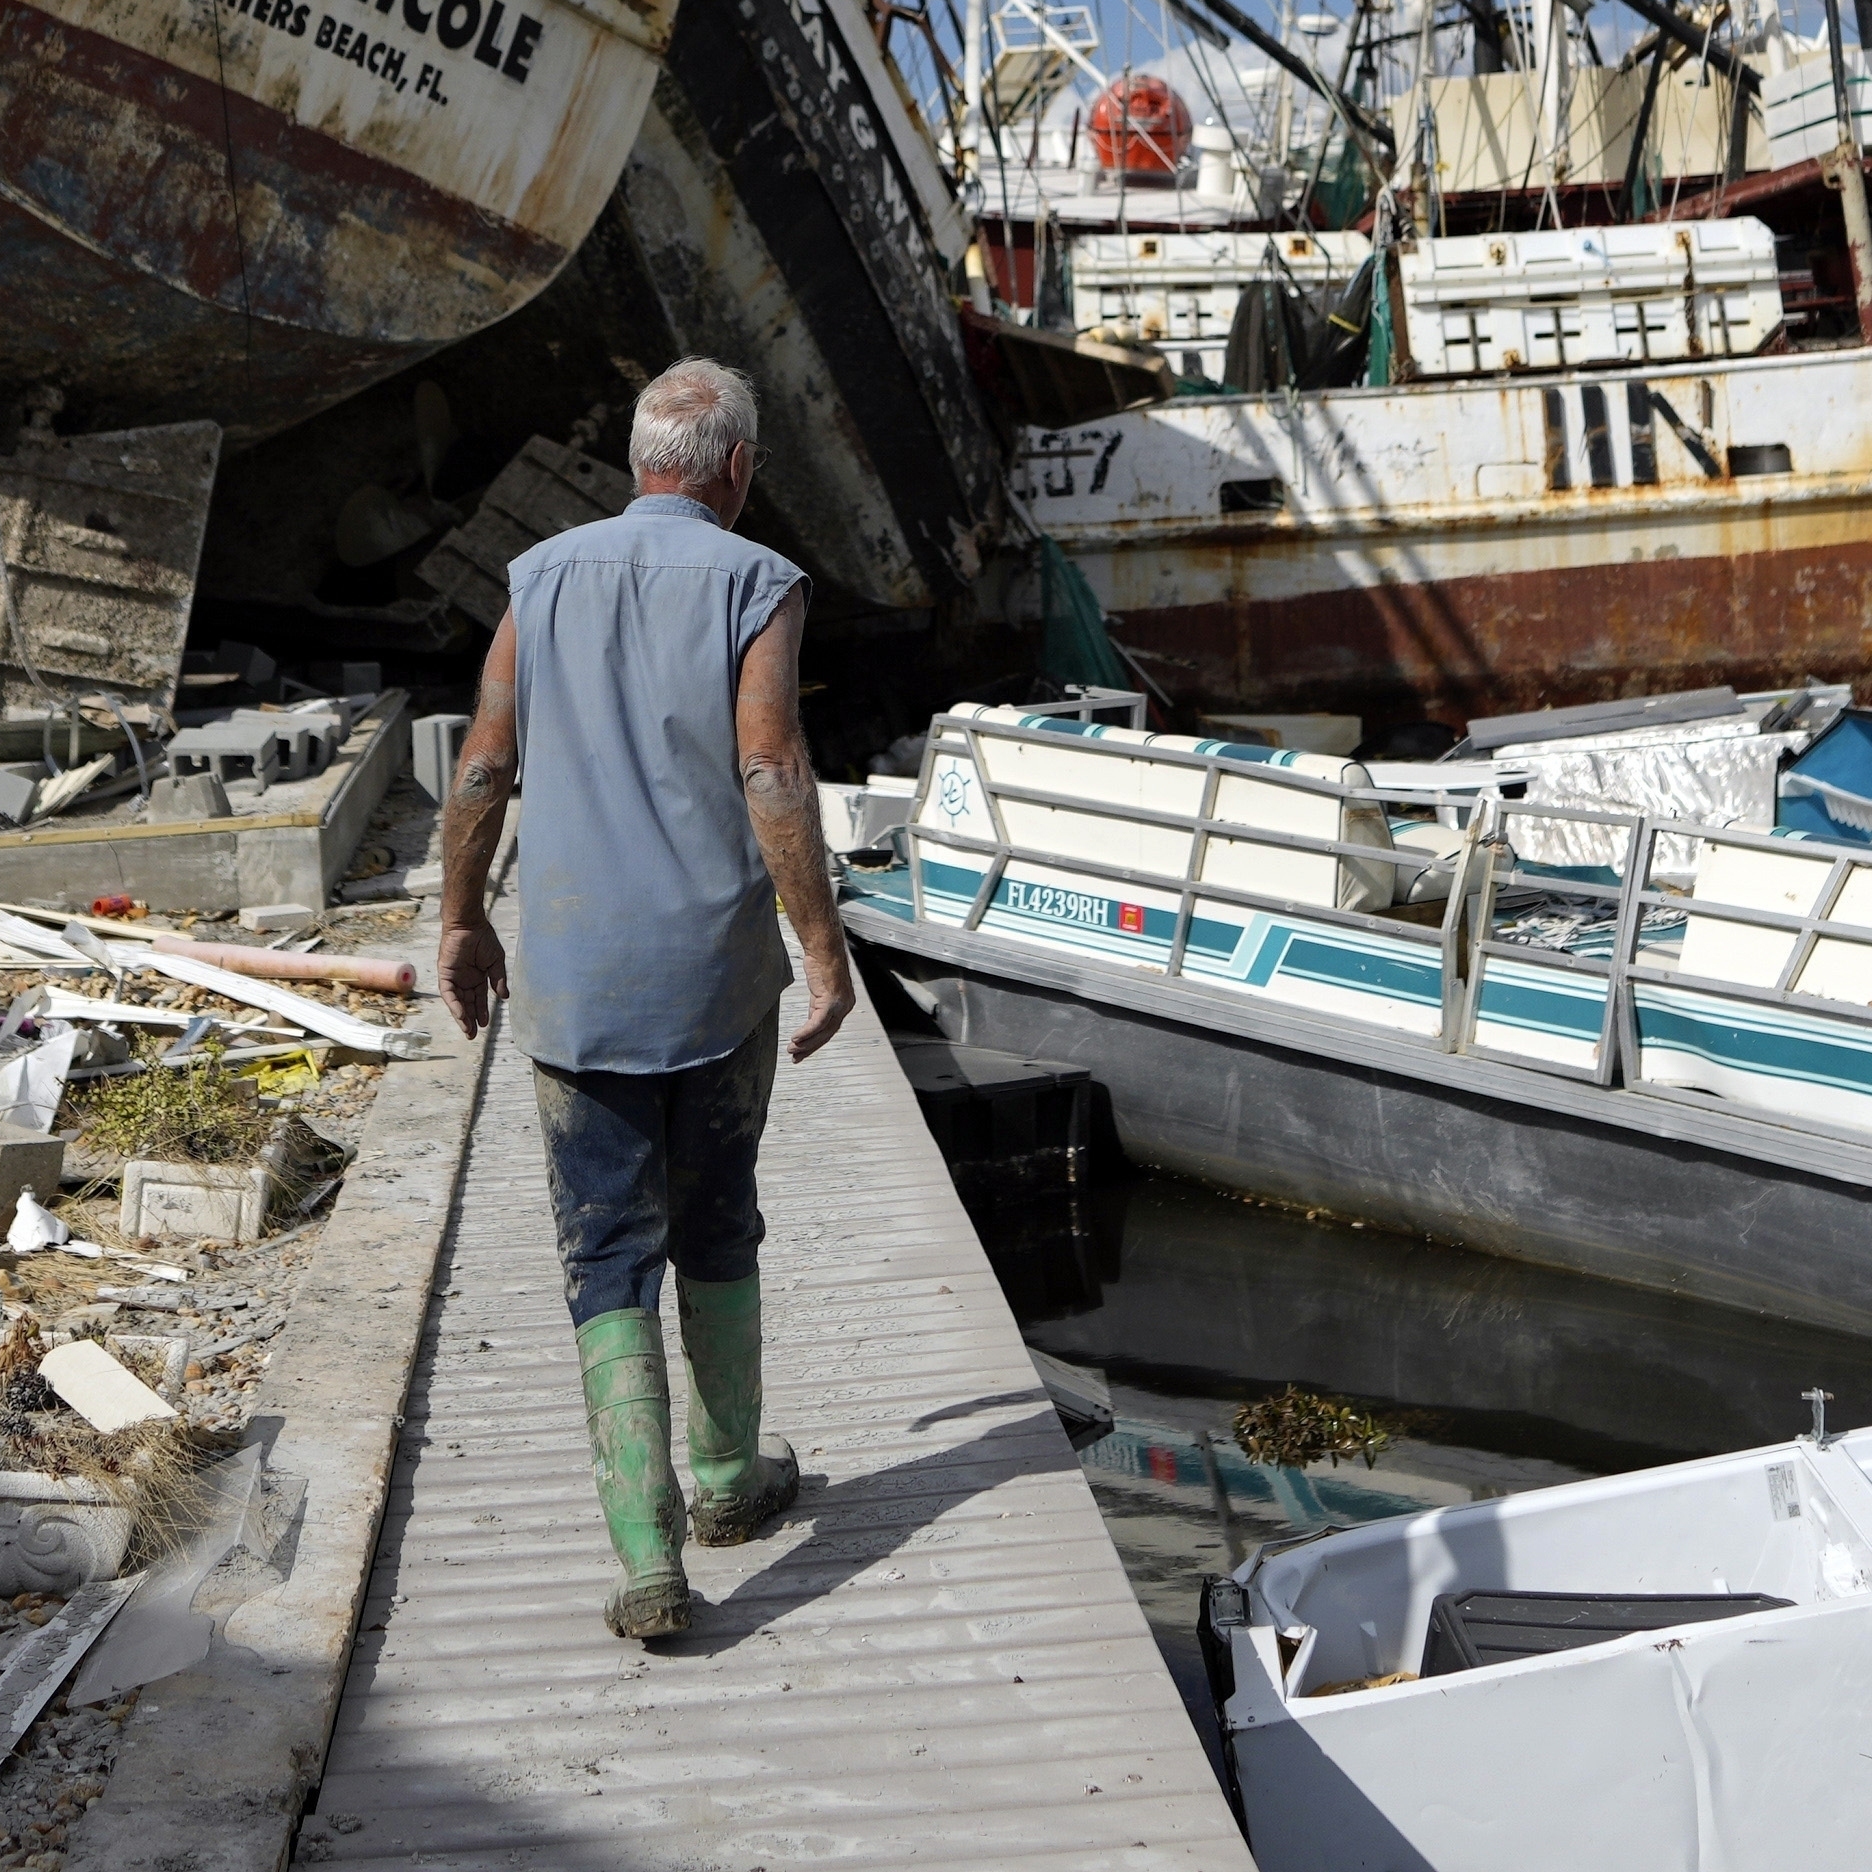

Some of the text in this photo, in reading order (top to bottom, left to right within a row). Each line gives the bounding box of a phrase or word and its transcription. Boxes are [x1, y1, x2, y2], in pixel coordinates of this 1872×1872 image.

[315, 16, 409, 93] BEACH,
[414, 64, 448, 106] FL.
[1006, 881, 1110, 927] FL4239RH
